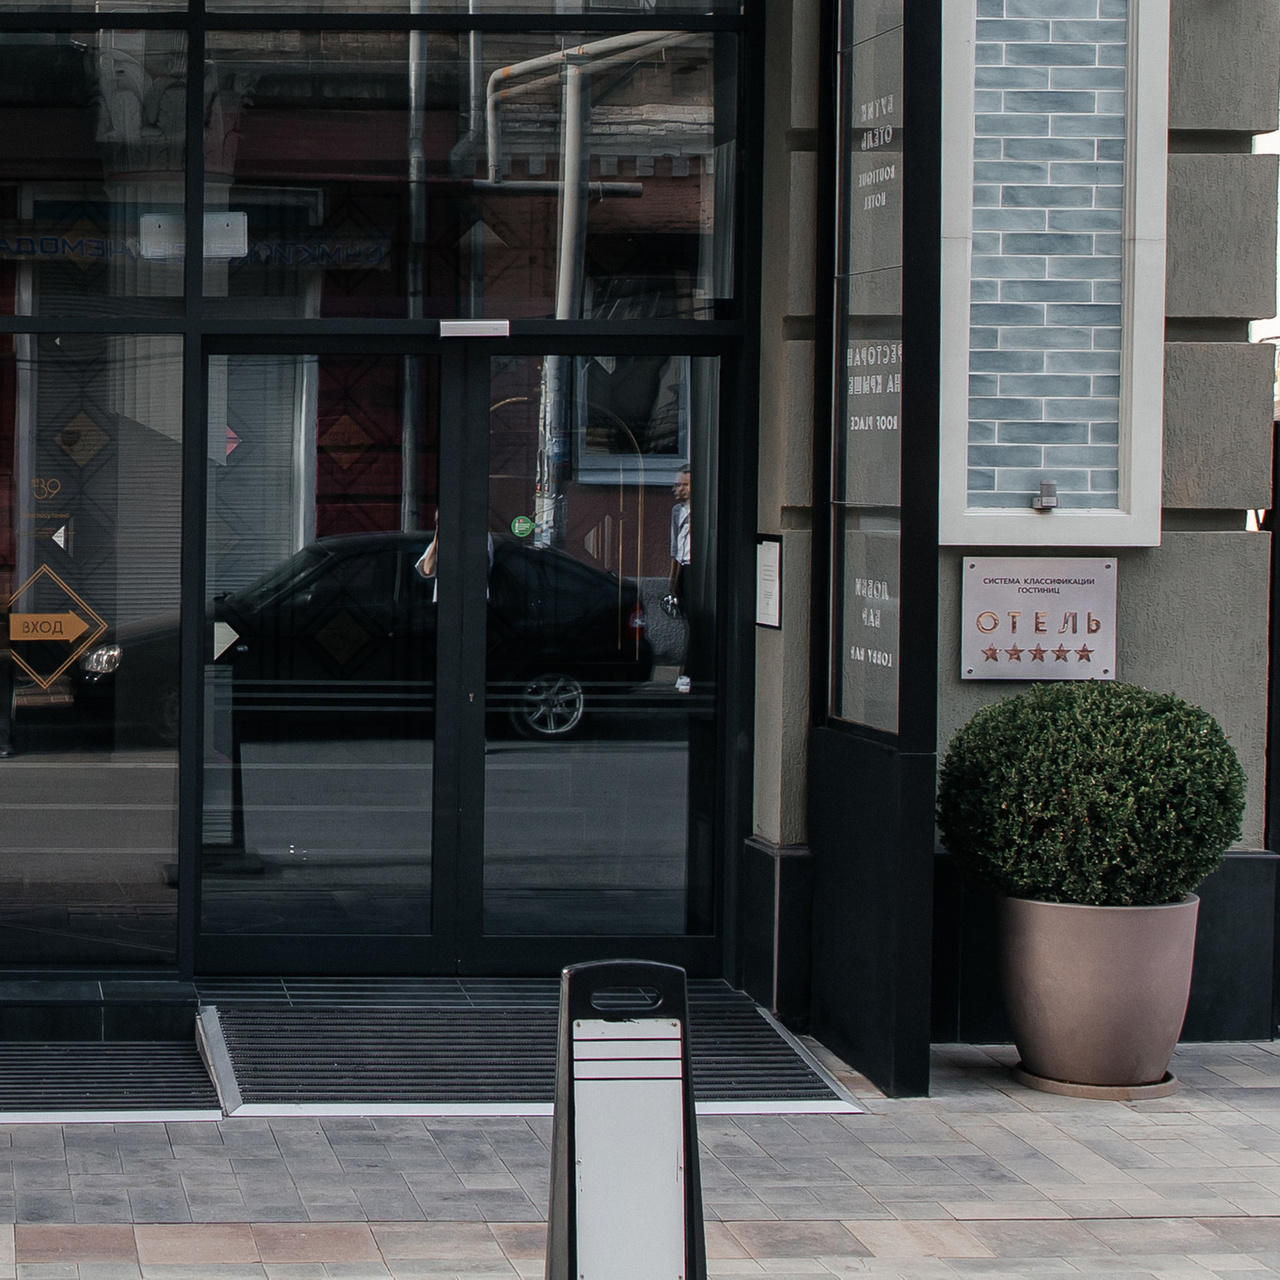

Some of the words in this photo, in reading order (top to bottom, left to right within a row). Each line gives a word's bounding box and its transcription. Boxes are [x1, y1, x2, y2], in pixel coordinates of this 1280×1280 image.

[983, 577, 1020, 585] СИСТЕМА
[1023, 578, 1095, 586] КЛАССИФИКАЦИИ
[1018, 587, 1060, 595] ГОСТИНИЦ
[22, 621, 63, 635] ВХОД
[976, 611, 1101, 634] ОТЕЛЬ
